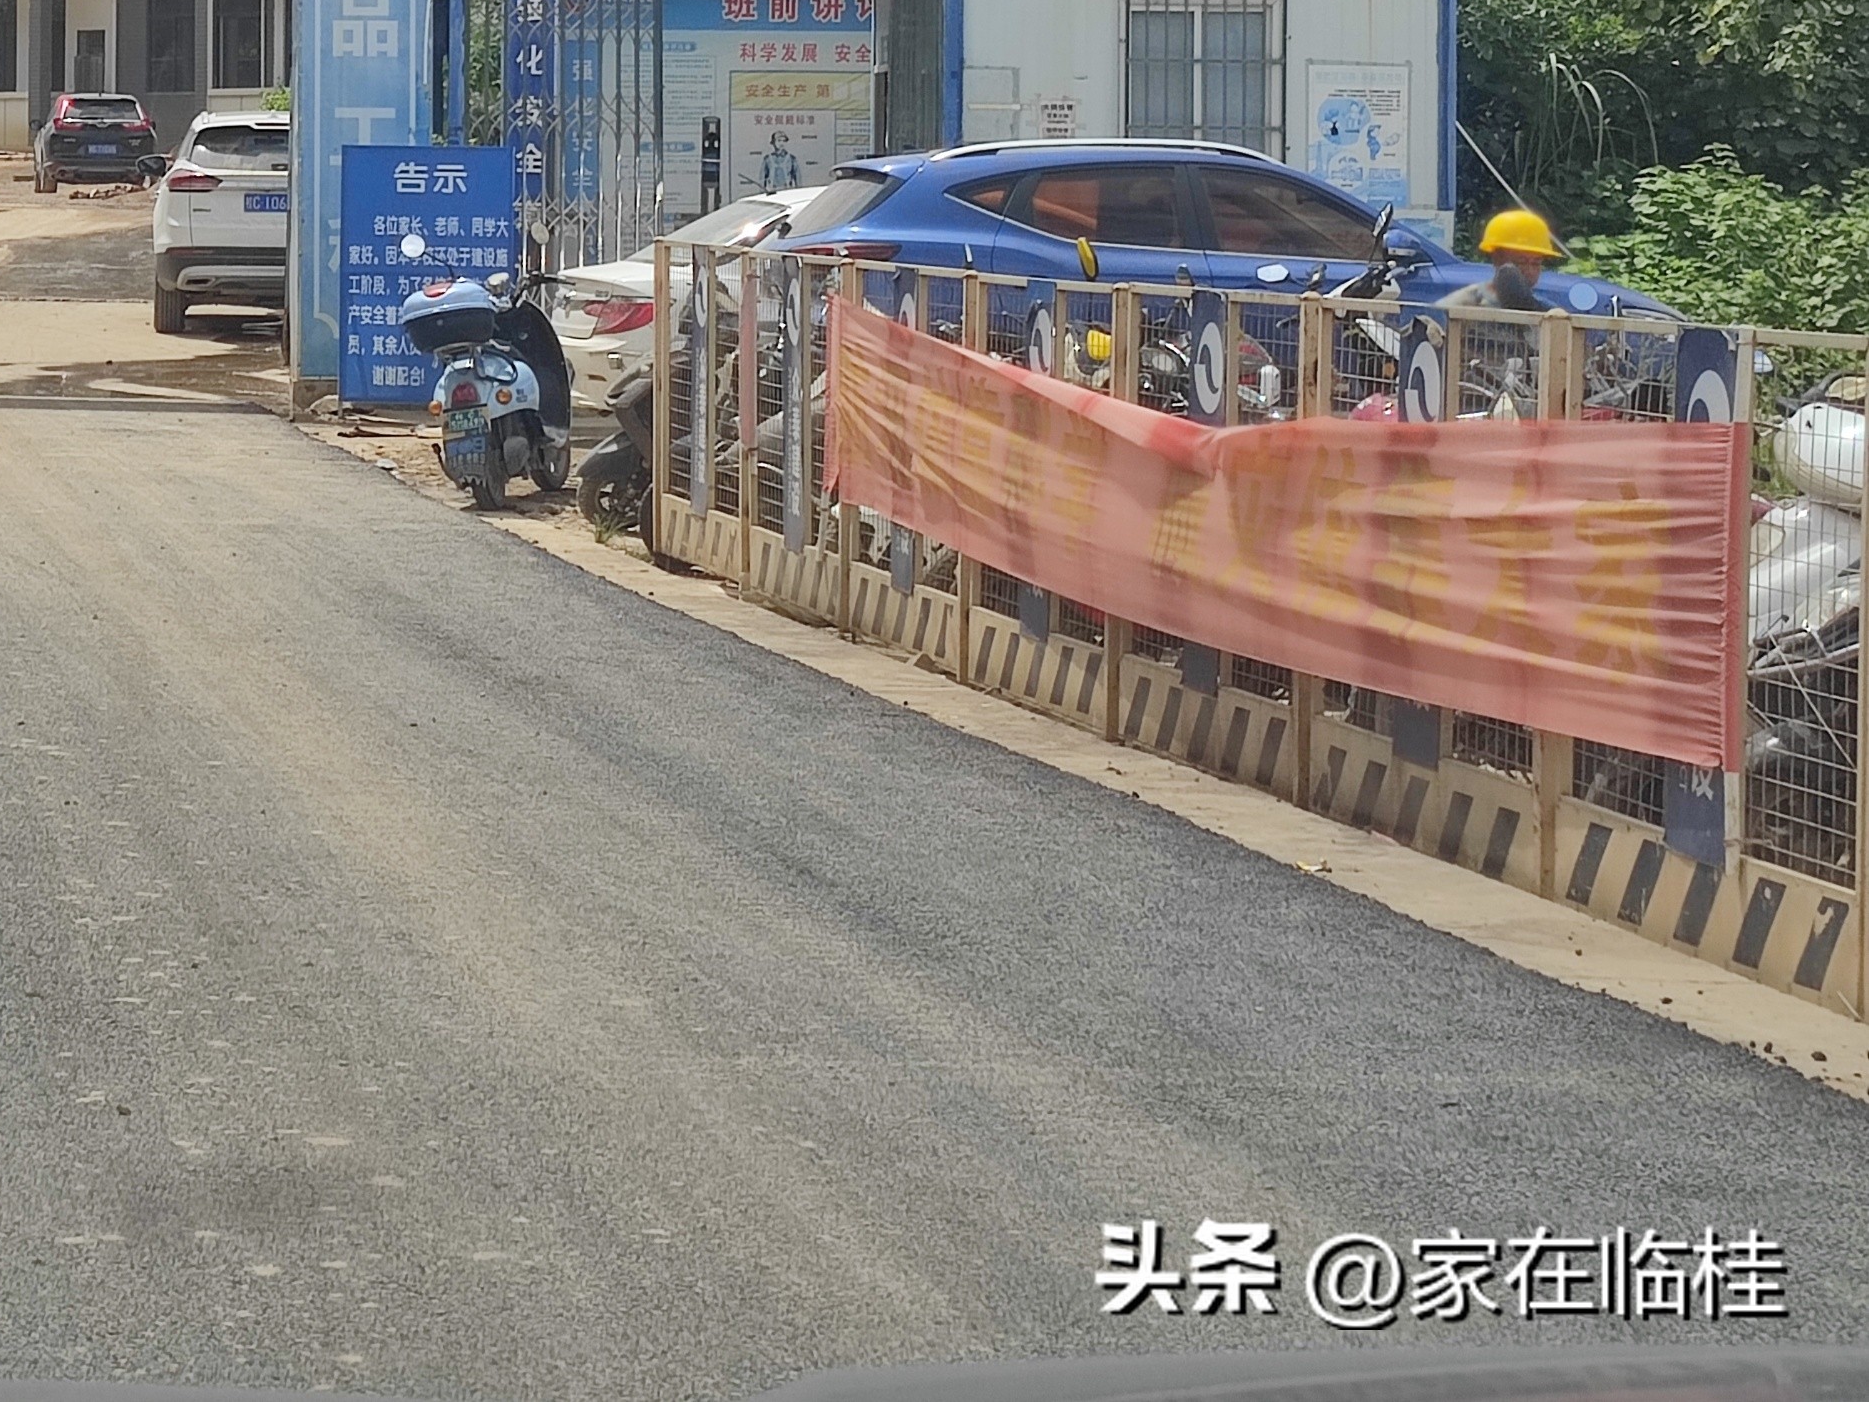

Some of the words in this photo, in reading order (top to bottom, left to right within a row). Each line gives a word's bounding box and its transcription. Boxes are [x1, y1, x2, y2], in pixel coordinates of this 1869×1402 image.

[739, 43, 818, 63] 科学发展
[745, 84, 807, 98] 安全生产
[393, 161, 468, 194] 告示
